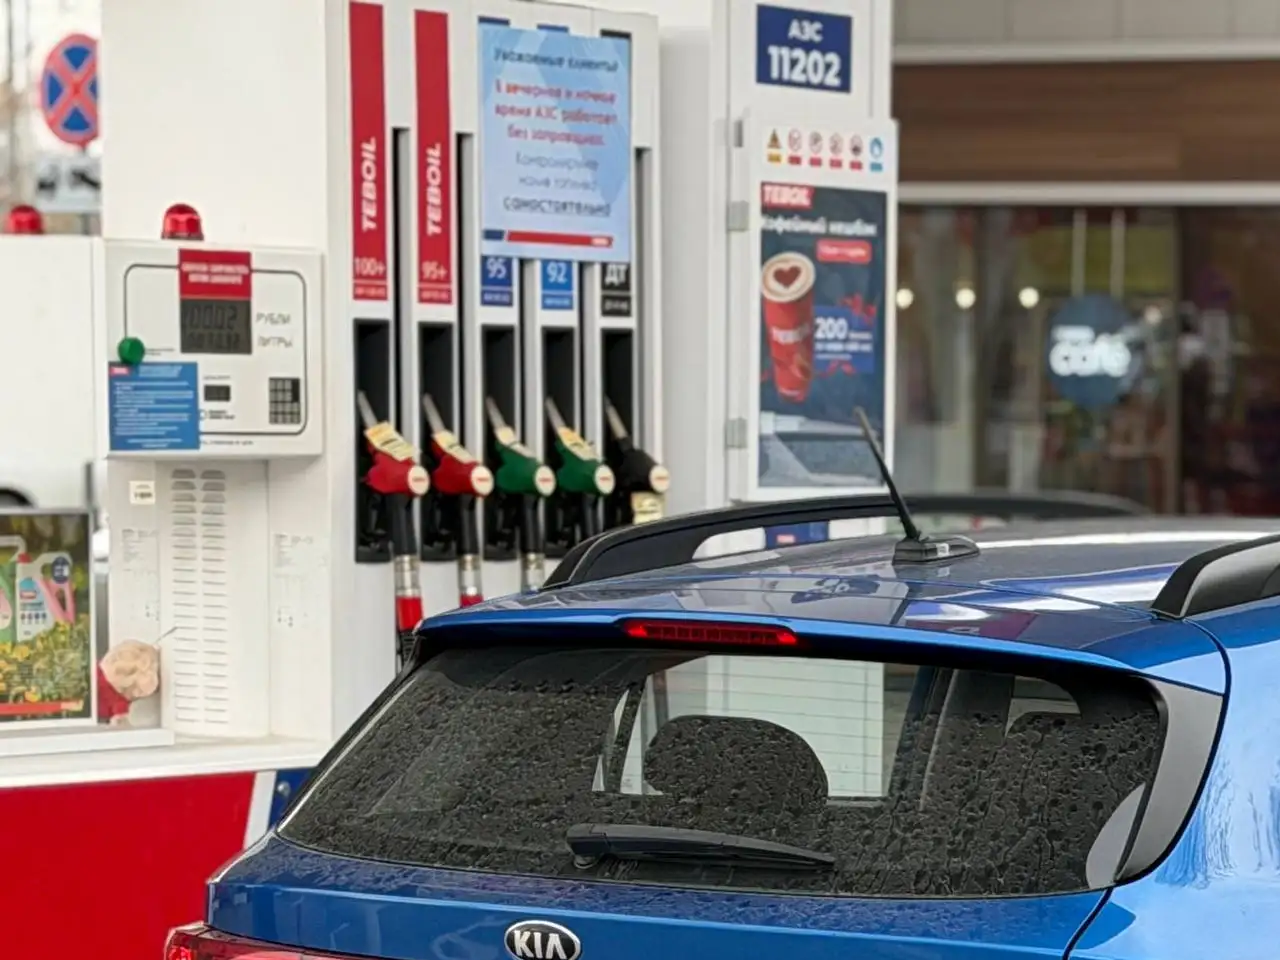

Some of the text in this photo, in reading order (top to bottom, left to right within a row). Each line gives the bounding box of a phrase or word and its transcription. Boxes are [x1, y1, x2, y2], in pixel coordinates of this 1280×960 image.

[767, 45, 842, 87] 11202
[361, 136, 377, 233] TEBOIL
[426, 142, 442, 237] TEBOIL
[354, 257, 385, 277] 100+
[421, 261, 448, 280] 95+
[486, 257, 507, 280] 95
[546, 261, 567, 284] 92
[814, 316, 848, 340] 200
[513, 929, 567, 960] KIA
